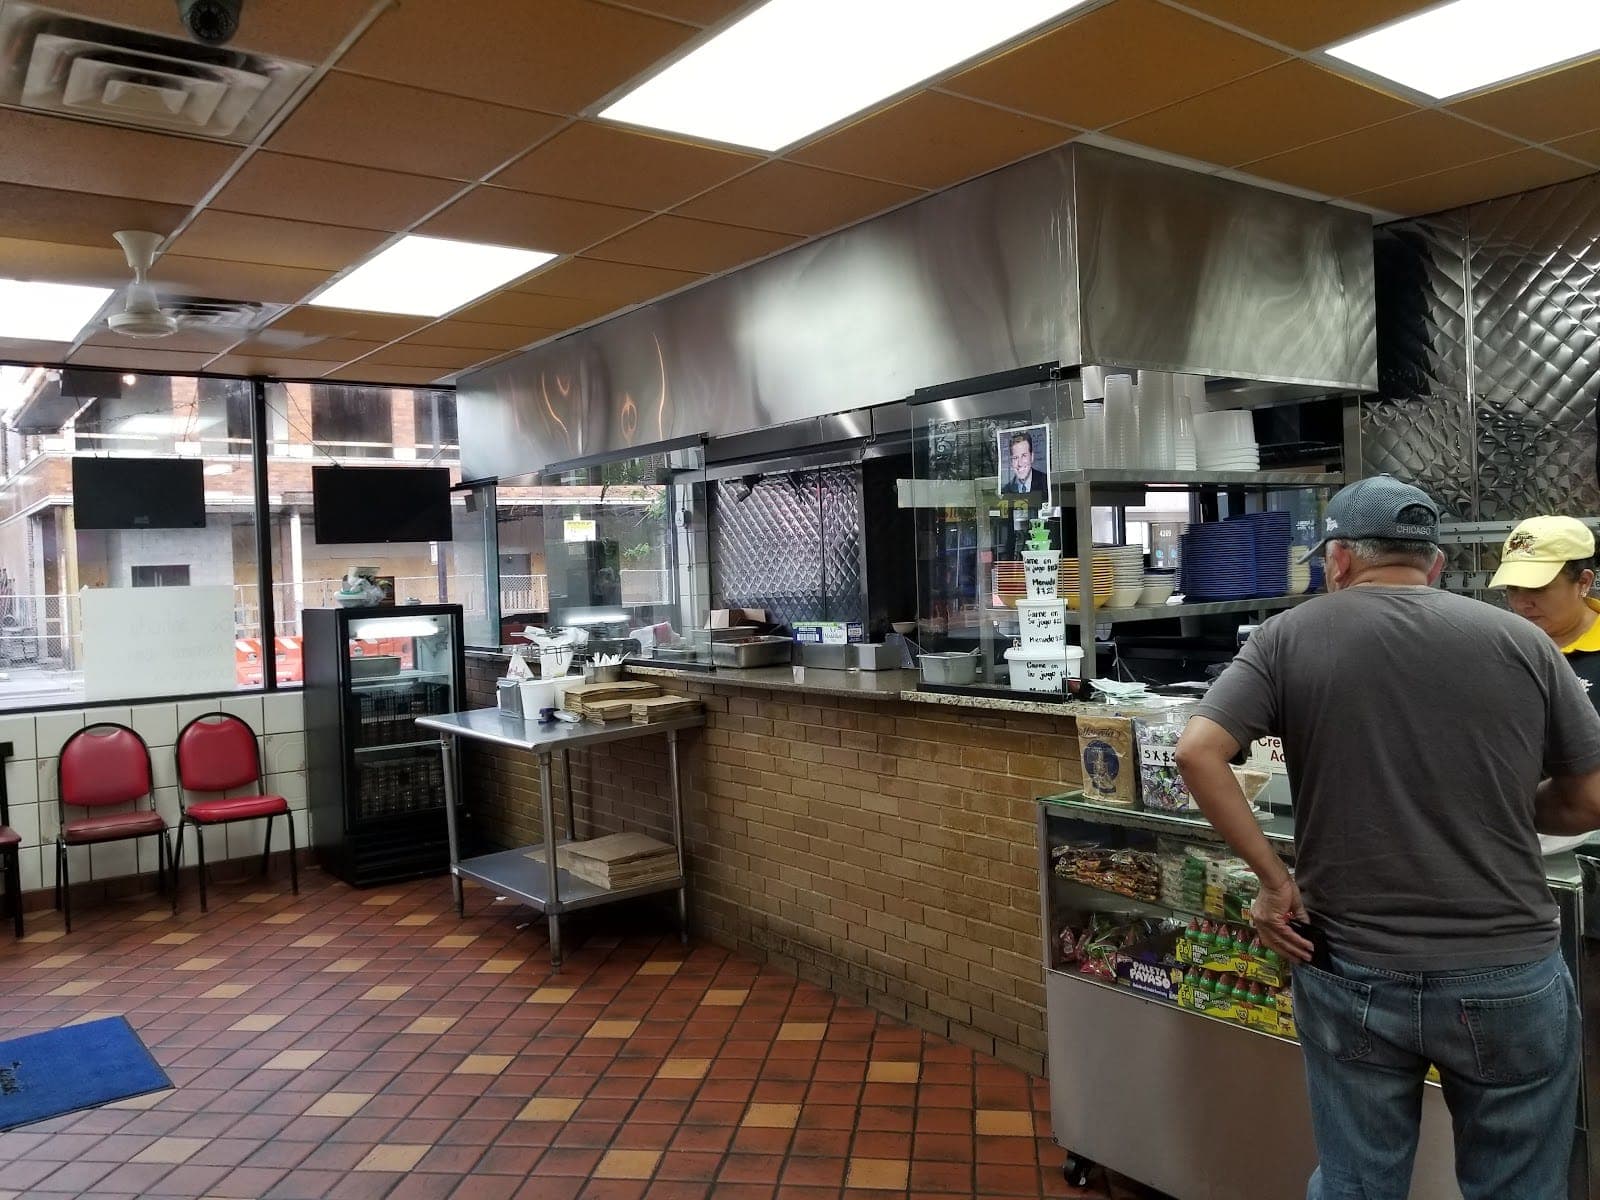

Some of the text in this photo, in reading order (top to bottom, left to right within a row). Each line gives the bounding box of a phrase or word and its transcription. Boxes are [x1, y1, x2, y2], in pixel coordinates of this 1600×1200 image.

[1396, 525, 1431, 536] CHICAGO
[1130, 968, 1171, 989] PAYASO
[1133, 961, 1167, 979] PALETA
